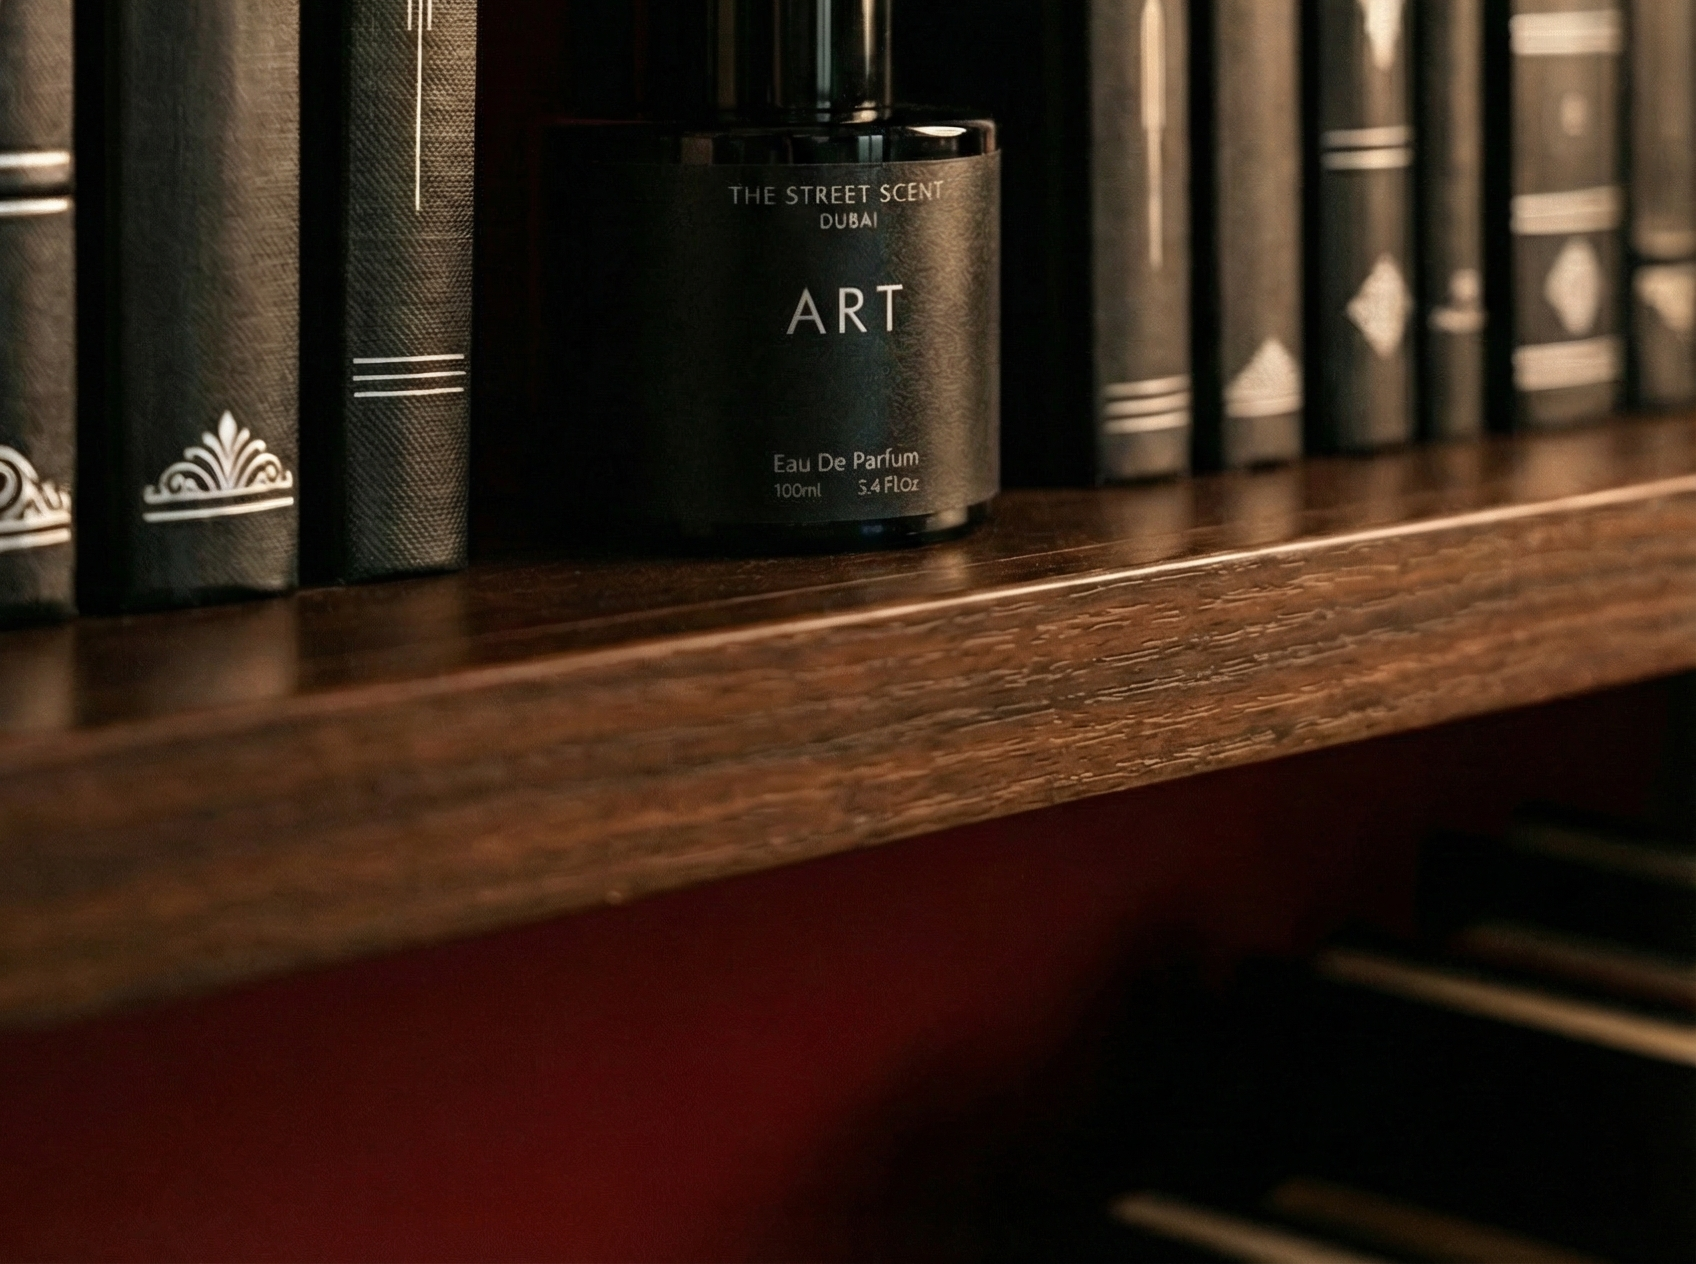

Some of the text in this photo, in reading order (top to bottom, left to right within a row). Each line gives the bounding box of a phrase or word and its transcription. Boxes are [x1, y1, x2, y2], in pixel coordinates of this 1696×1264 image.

[728, 180, 944, 205] THE STREET SCENT
[819, 211, 878, 229] DUBAI
[786, 284, 903, 335] ART
[773, 448, 919, 473] Eau De Parfum
[774, 482, 822, 499] 100ml
